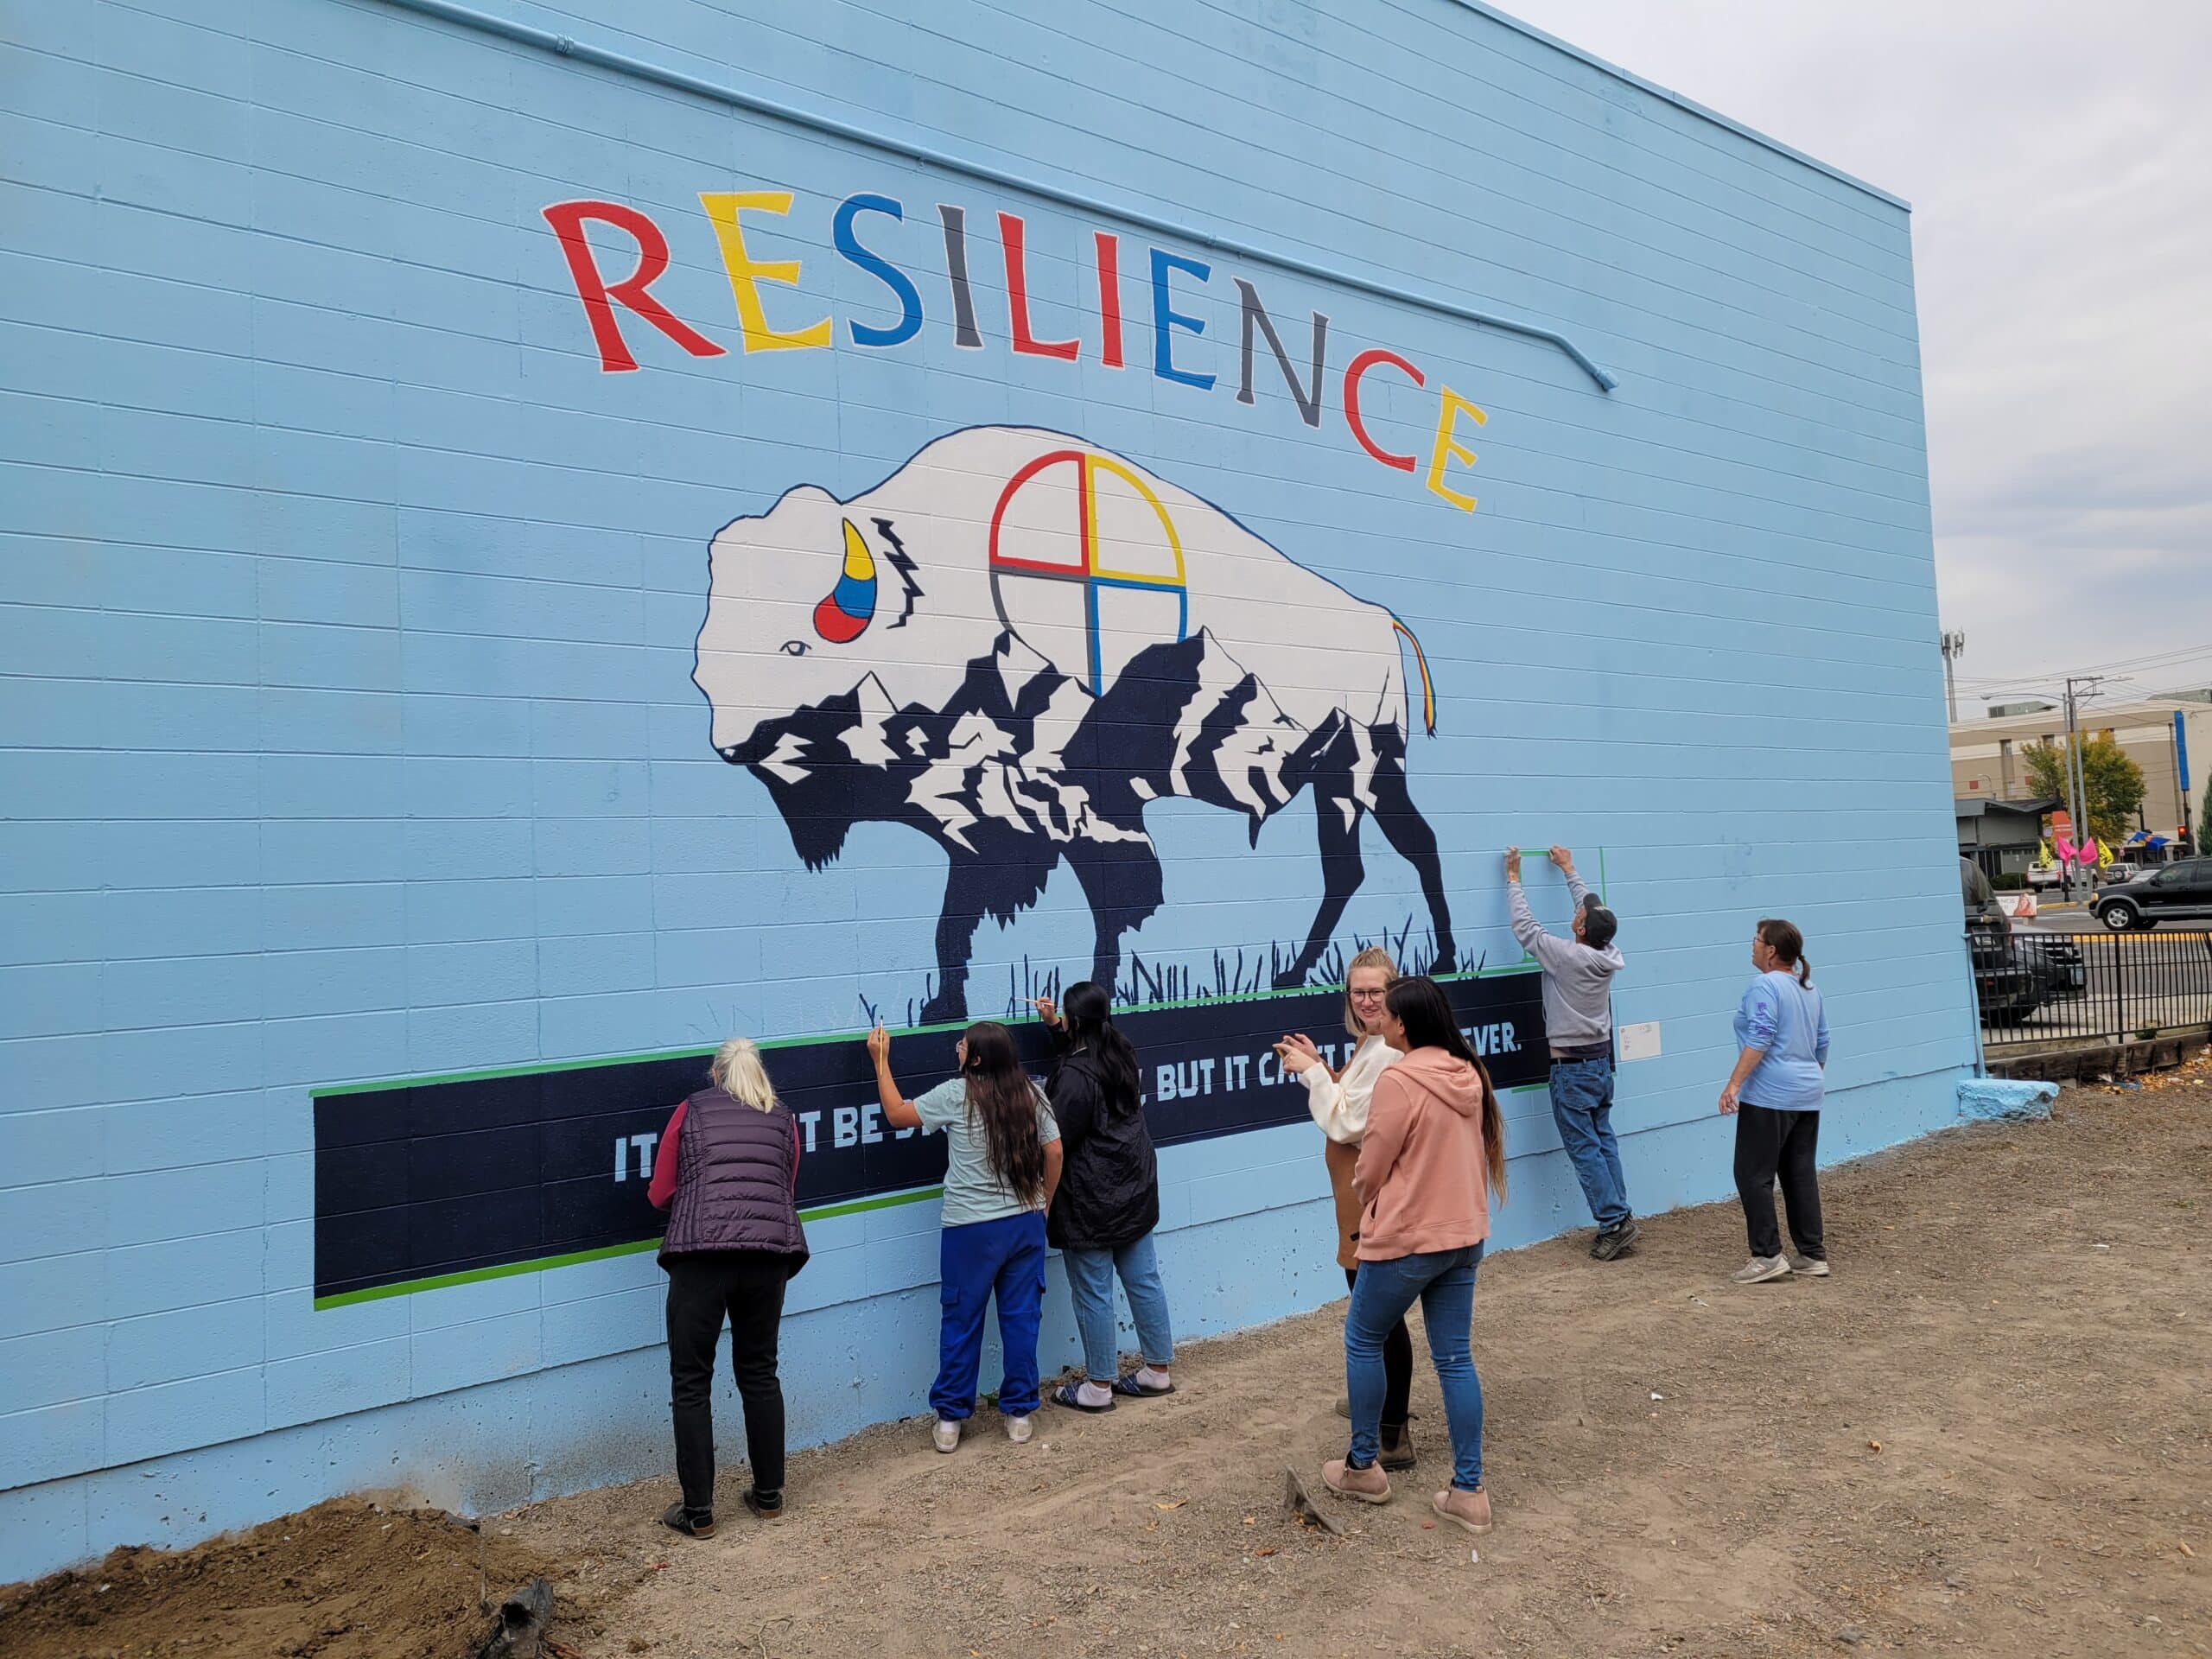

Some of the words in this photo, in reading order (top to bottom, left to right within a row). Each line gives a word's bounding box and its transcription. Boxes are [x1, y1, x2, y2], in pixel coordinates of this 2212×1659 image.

[542, 189, 1488, 513] RESILIENCE
[614, 1133, 658, 1183] IT
[833, 1103, 883, 1148] BE
[1157, 1058, 1215, 1102] BUT
[1224, 1055, 1249, 1092] IT
